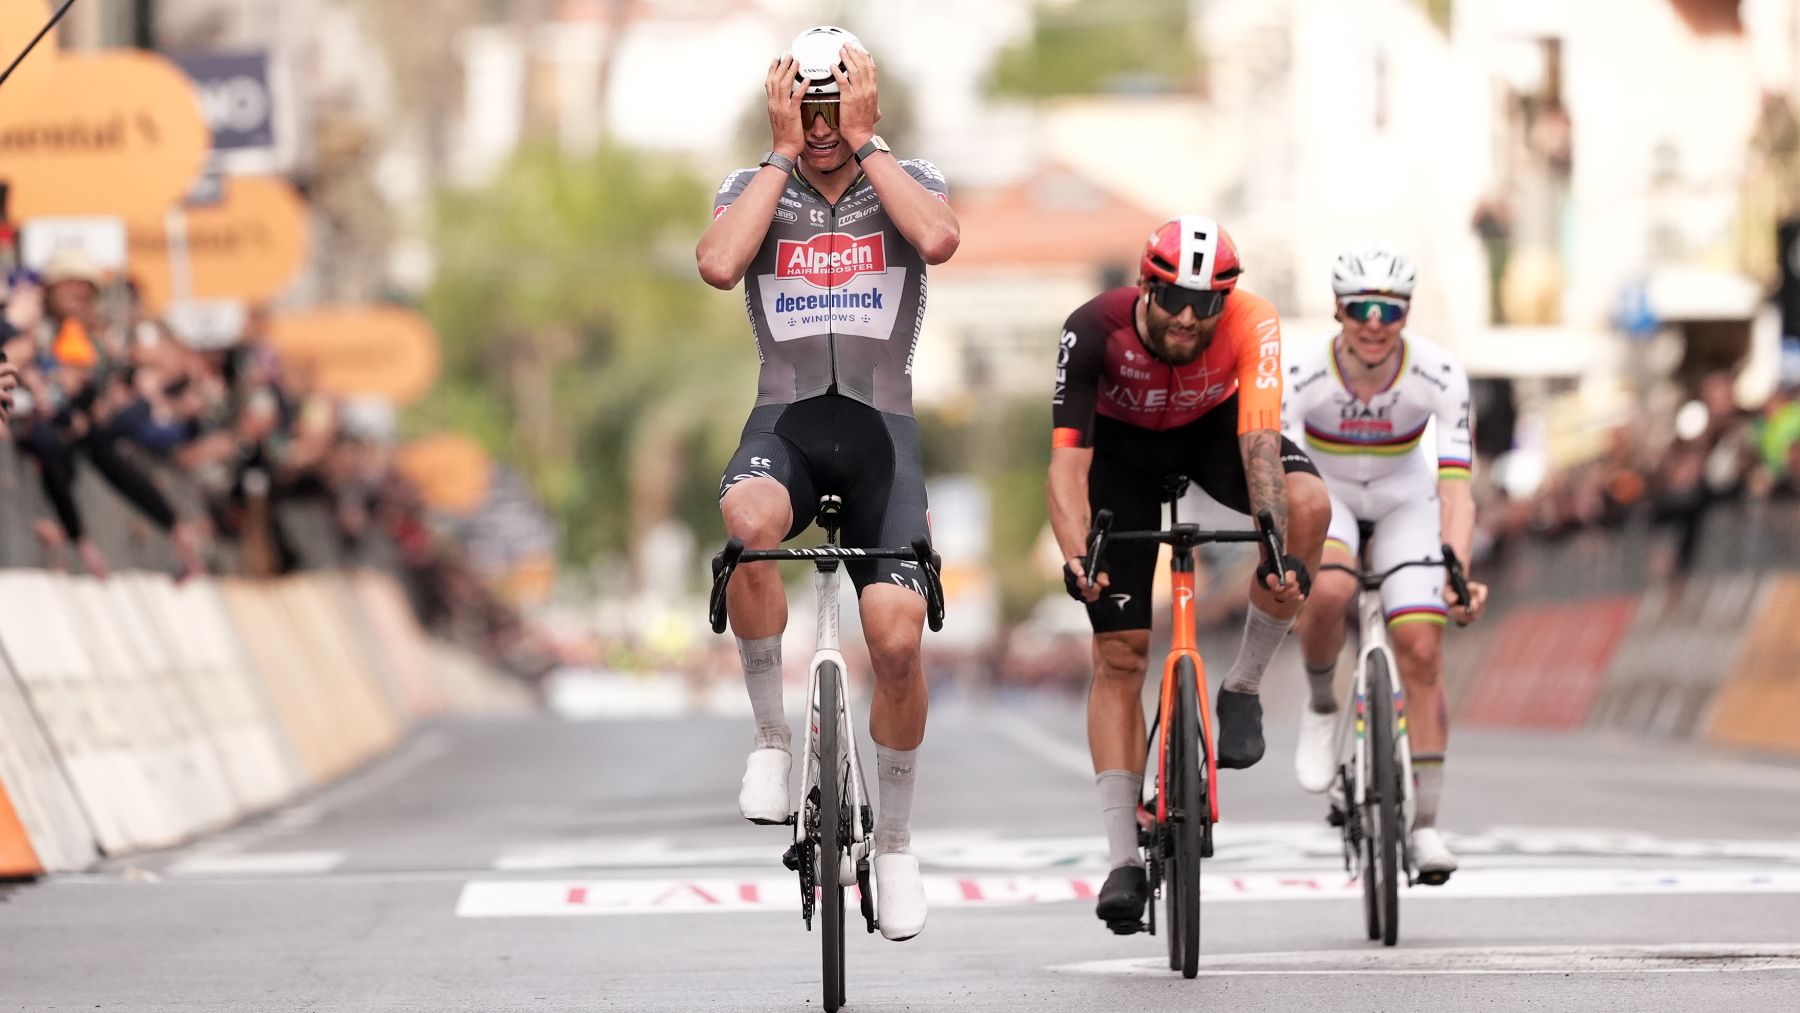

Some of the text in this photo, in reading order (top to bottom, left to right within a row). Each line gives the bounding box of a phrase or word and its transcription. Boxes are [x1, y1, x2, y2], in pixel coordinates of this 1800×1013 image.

[788, 242, 873, 274] Alpecin
[820, 264, 873, 274] BOOSTER
[775, 287, 883, 313] deceuninck
[801, 314, 856, 324] WINDOWS
[1052, 329, 1077, 405] INEOS
[1256, 318, 1279, 390] INEOS
[1105, 384, 1224, 407] INEOS
